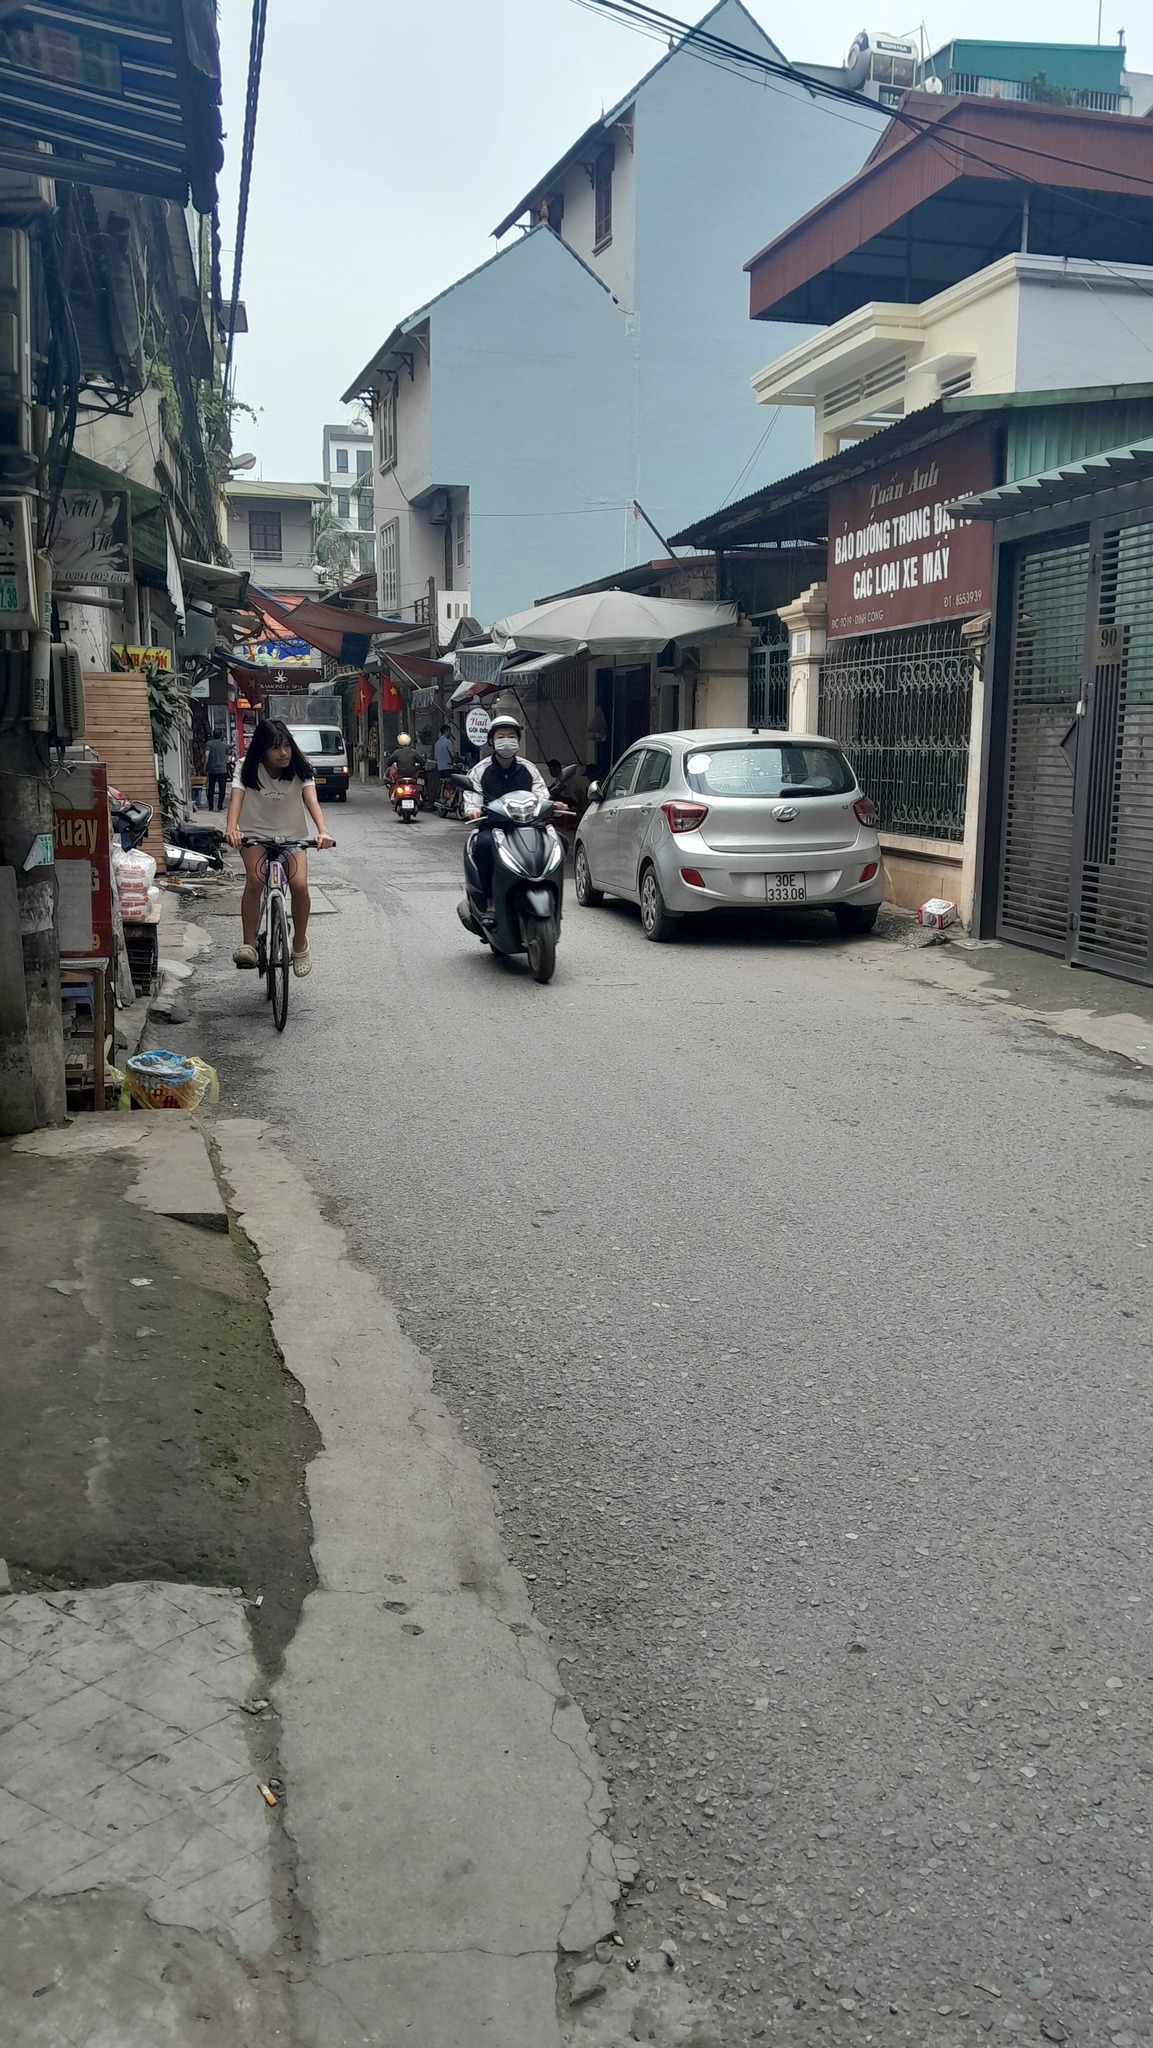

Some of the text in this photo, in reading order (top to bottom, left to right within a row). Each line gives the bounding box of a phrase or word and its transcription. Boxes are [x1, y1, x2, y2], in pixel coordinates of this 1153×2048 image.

[869, 461, 939, 509] Tuấn Anh
[835, 521, 854, 565] BẢO
[892, 505, 930, 548] TRUNG
[90, 572, 109, 582] 002
[111, 572, 129, 583] 667
[853, 541, 950, 600] CÁC LOẠI XE MÁY
[1101, 627, 1117, 648] 90
[55, 813, 98, 855] uay
[768, 888, 804, 901] 333.08
[775, 874, 796, 887] 30E
